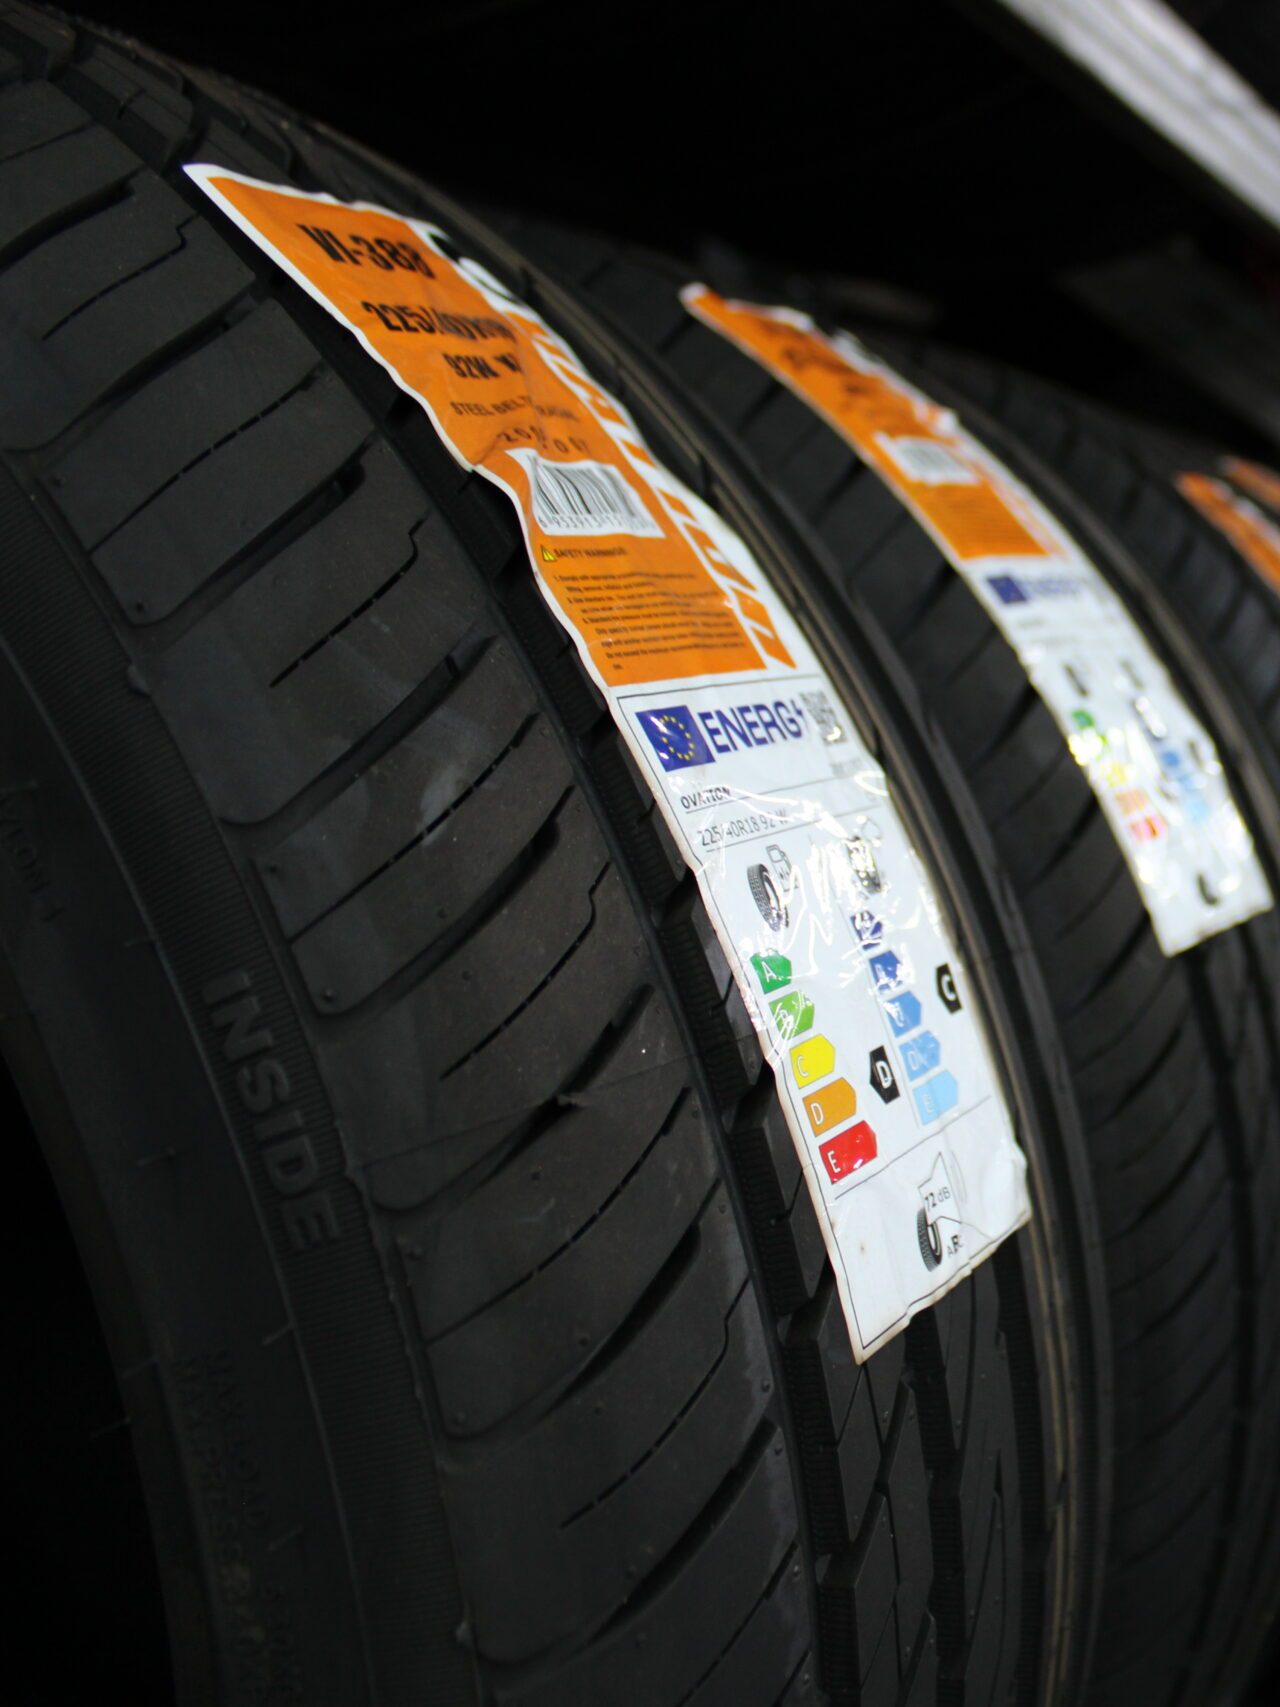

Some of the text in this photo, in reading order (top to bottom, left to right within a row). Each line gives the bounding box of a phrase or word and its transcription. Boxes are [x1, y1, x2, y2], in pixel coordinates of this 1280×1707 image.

[450, 401, 495, 416] STEEL
[941, 974, 957, 1002] C
[796, 1055, 809, 1078] C
[875, 1060, 893, 1089] D
[203, 969, 341, 1252] INSIDE
[810, 1102, 824, 1126] D
[827, 1150, 842, 1175] E
